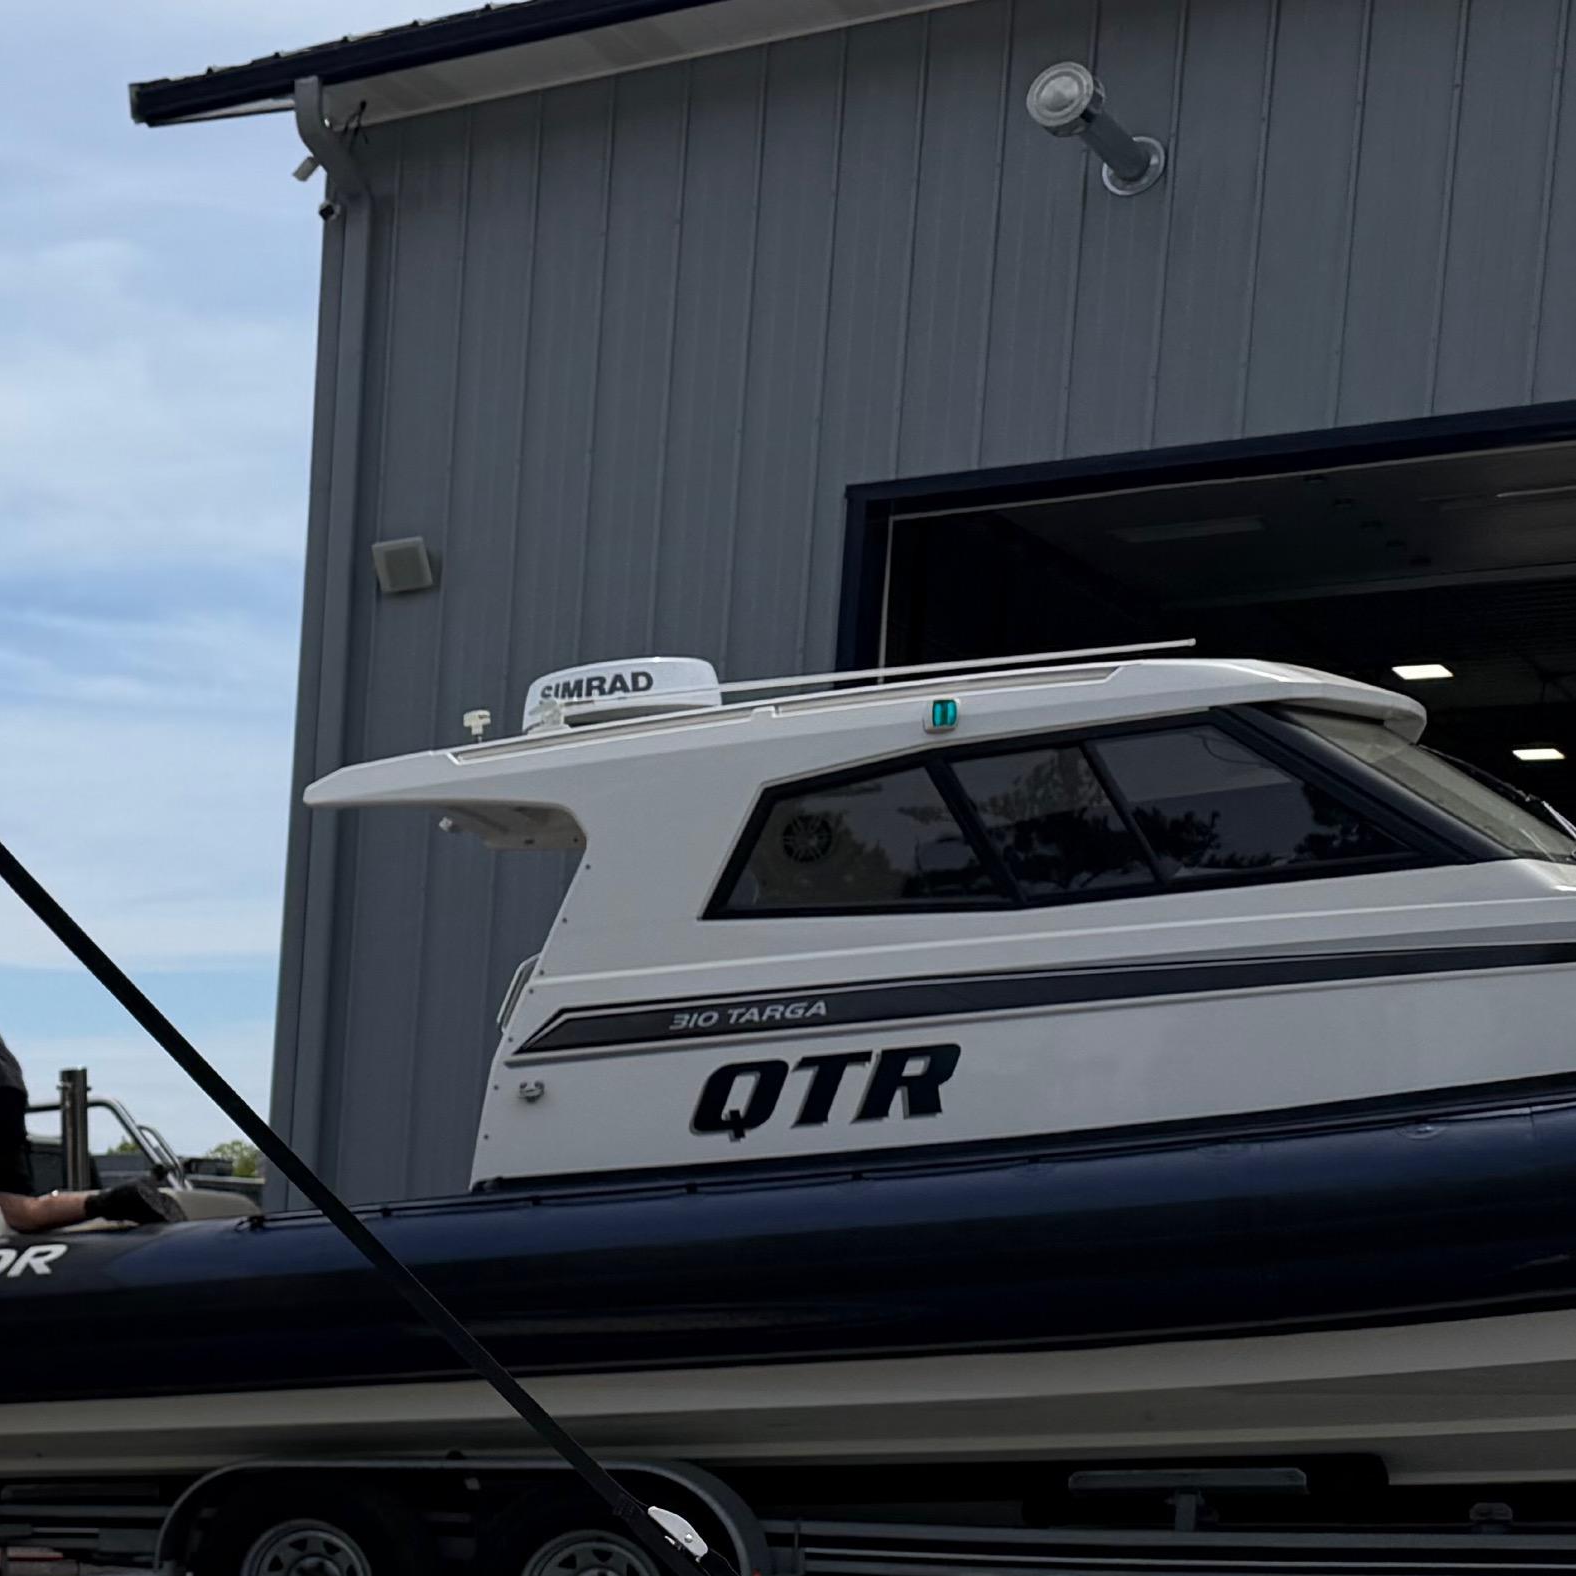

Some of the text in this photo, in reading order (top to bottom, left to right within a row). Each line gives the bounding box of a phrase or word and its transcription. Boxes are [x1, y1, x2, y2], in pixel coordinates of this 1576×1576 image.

[539, 671, 654, 700] SIMRAD
[668, 1000, 828, 1031] 310 TARGA
[689, 1043, 962, 1143] QTR
